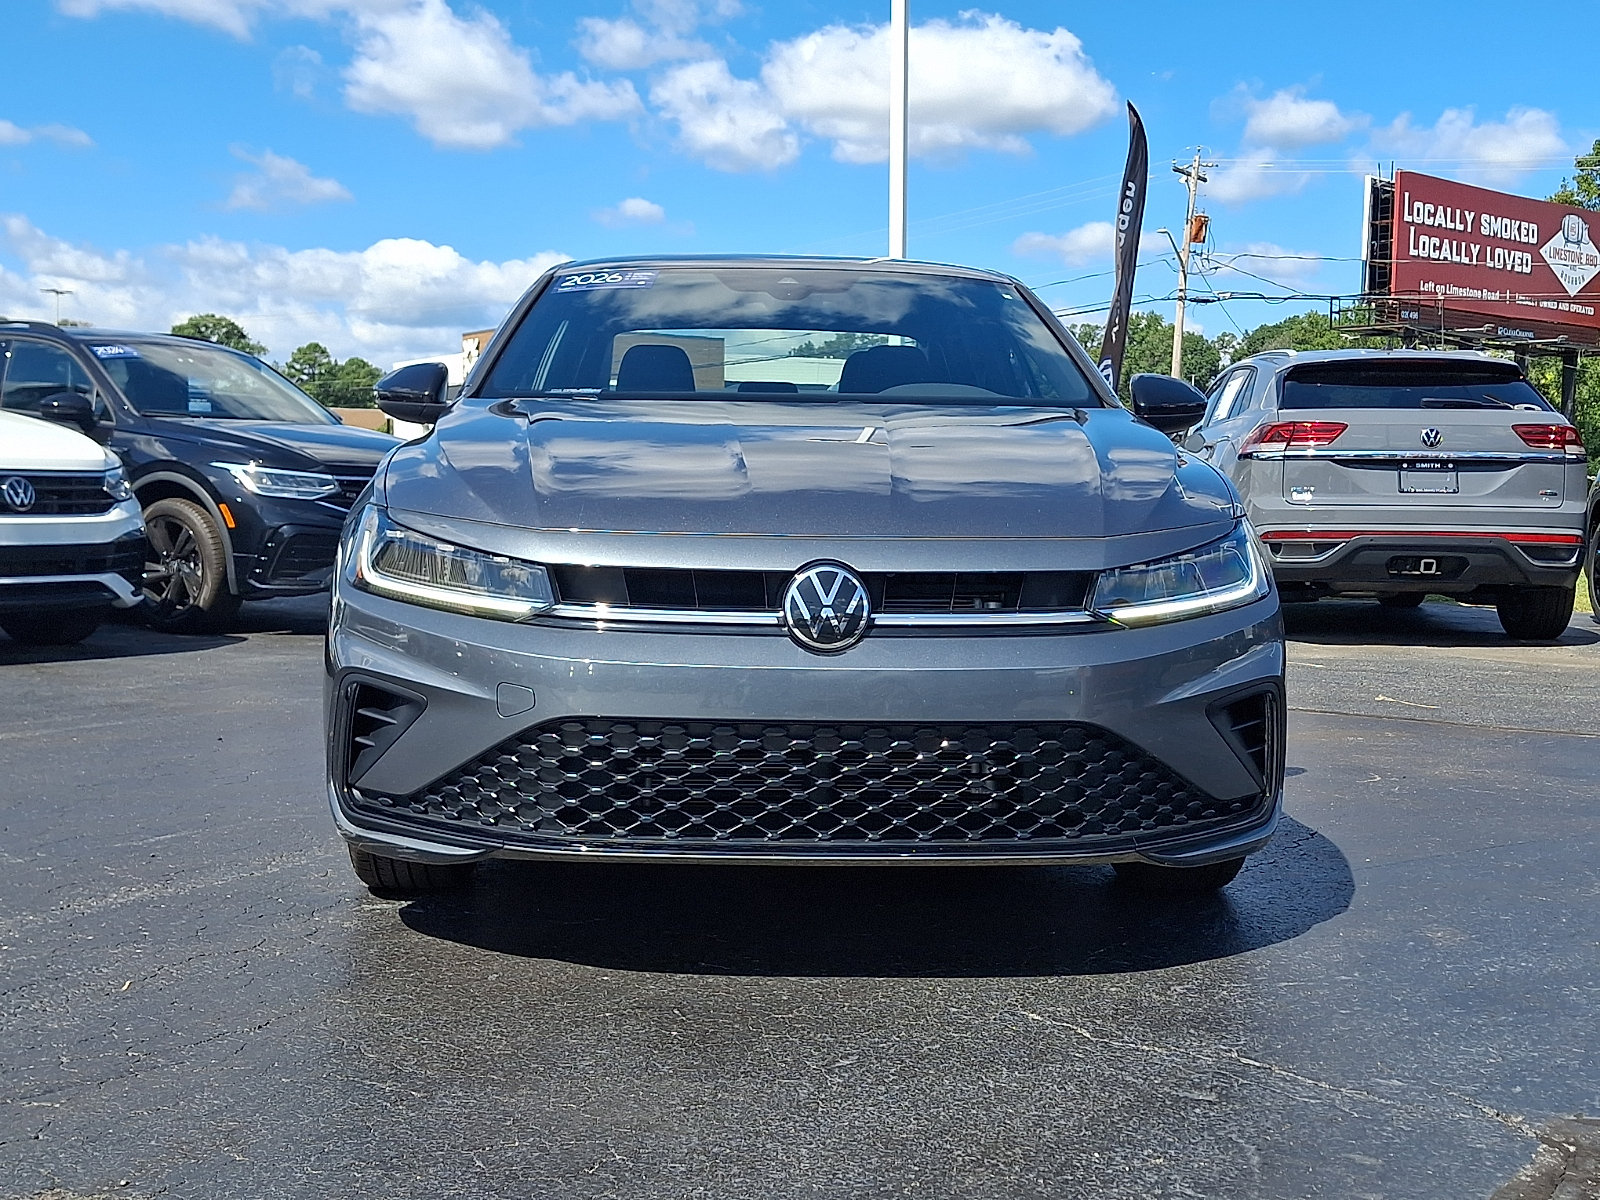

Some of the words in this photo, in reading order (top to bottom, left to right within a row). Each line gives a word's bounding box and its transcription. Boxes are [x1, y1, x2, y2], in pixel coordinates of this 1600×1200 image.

[1403, 191, 1475, 233] LOCALLY
[1480, 213, 1538, 244] SMOKED
[1408, 225, 1480, 265] LOCALLY
[1486, 245, 1532, 274] LOVED
[1549, 246, 1583, 265] LIMESTONE
[1585, 253, 1598, 269] BBQ
[560, 272, 623, 287] 2026
[1420, 279, 1434, 292] Left
[1446, 283, 1482, 299] Limestone
[1482, 288, 1500, 300] Road
[1560, 270, 1586, 286] BOURBON
[1421, 428, 1442, 447] VW
[5, 477, 35, 509] VW
[787, 567, 867, 645] VW
